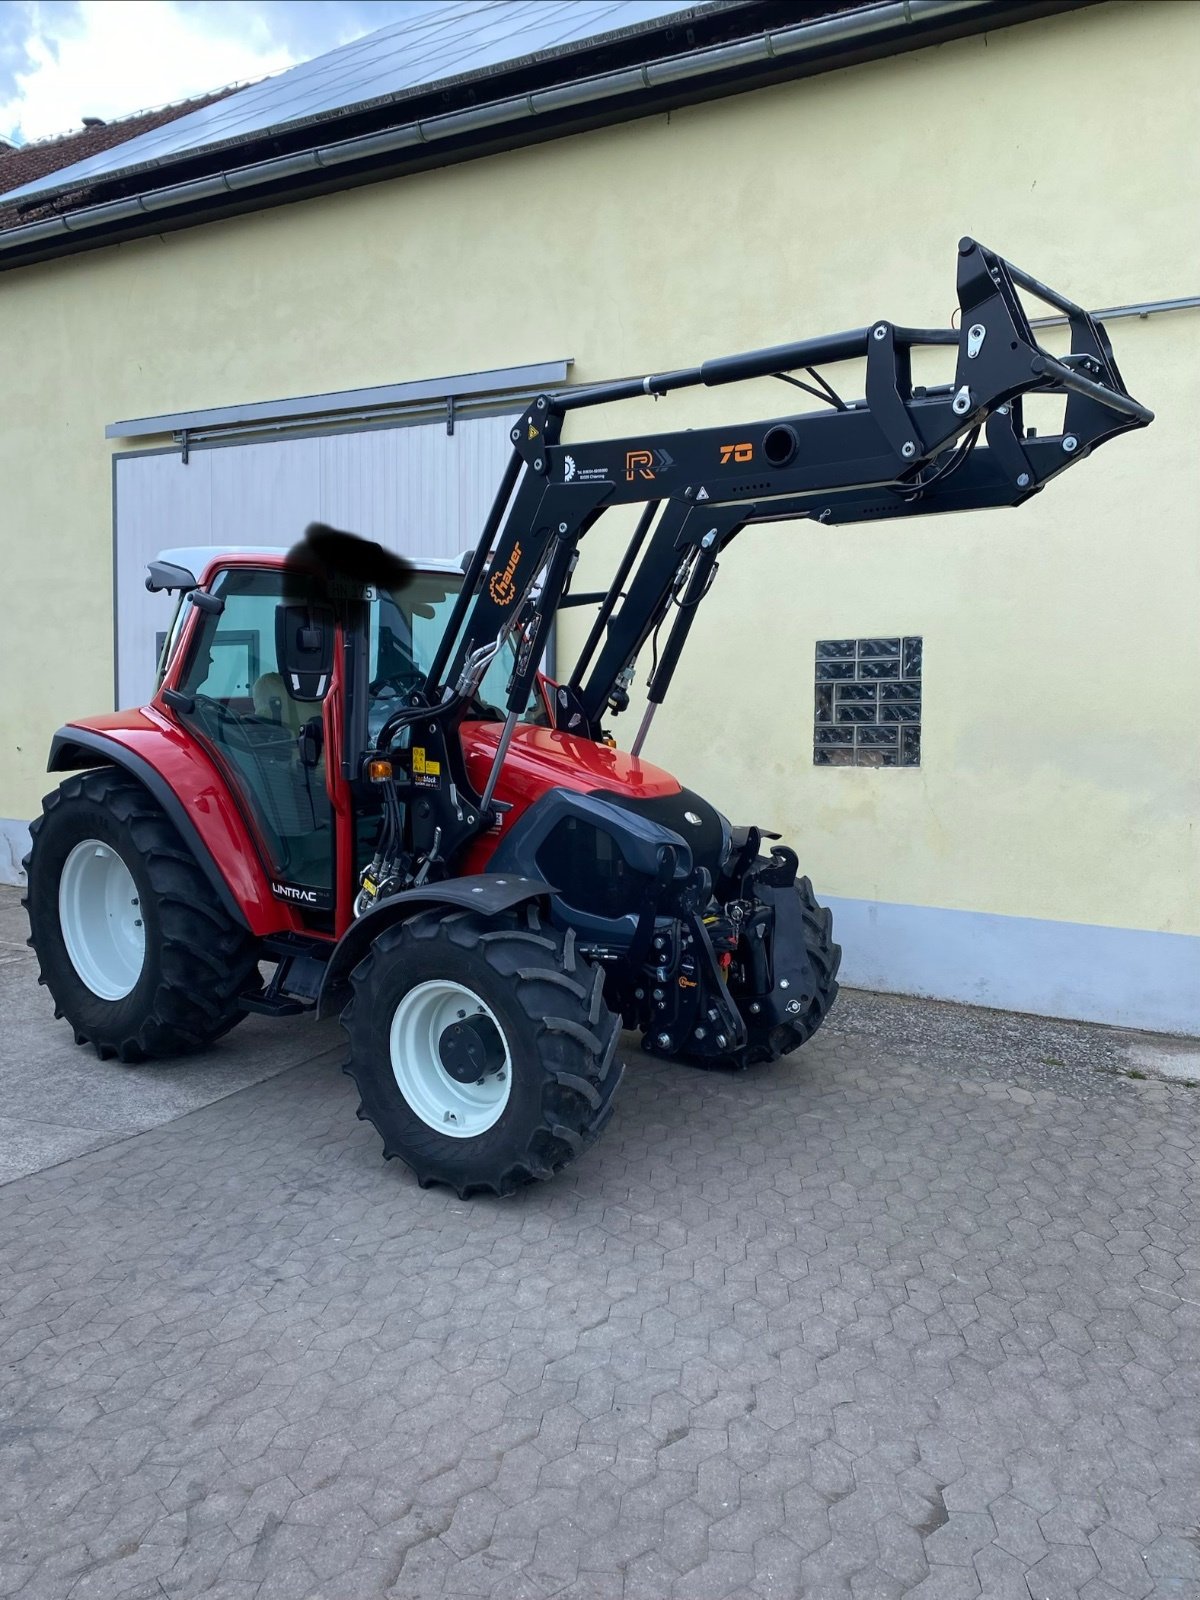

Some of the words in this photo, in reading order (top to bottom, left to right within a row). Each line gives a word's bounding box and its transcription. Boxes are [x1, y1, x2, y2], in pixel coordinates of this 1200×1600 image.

[626, 450, 656, 481] R
[720, 443, 753, 464] 70
[495, 540, 522, 597] hauer
[272, 882, 317, 902] LINTRAC
